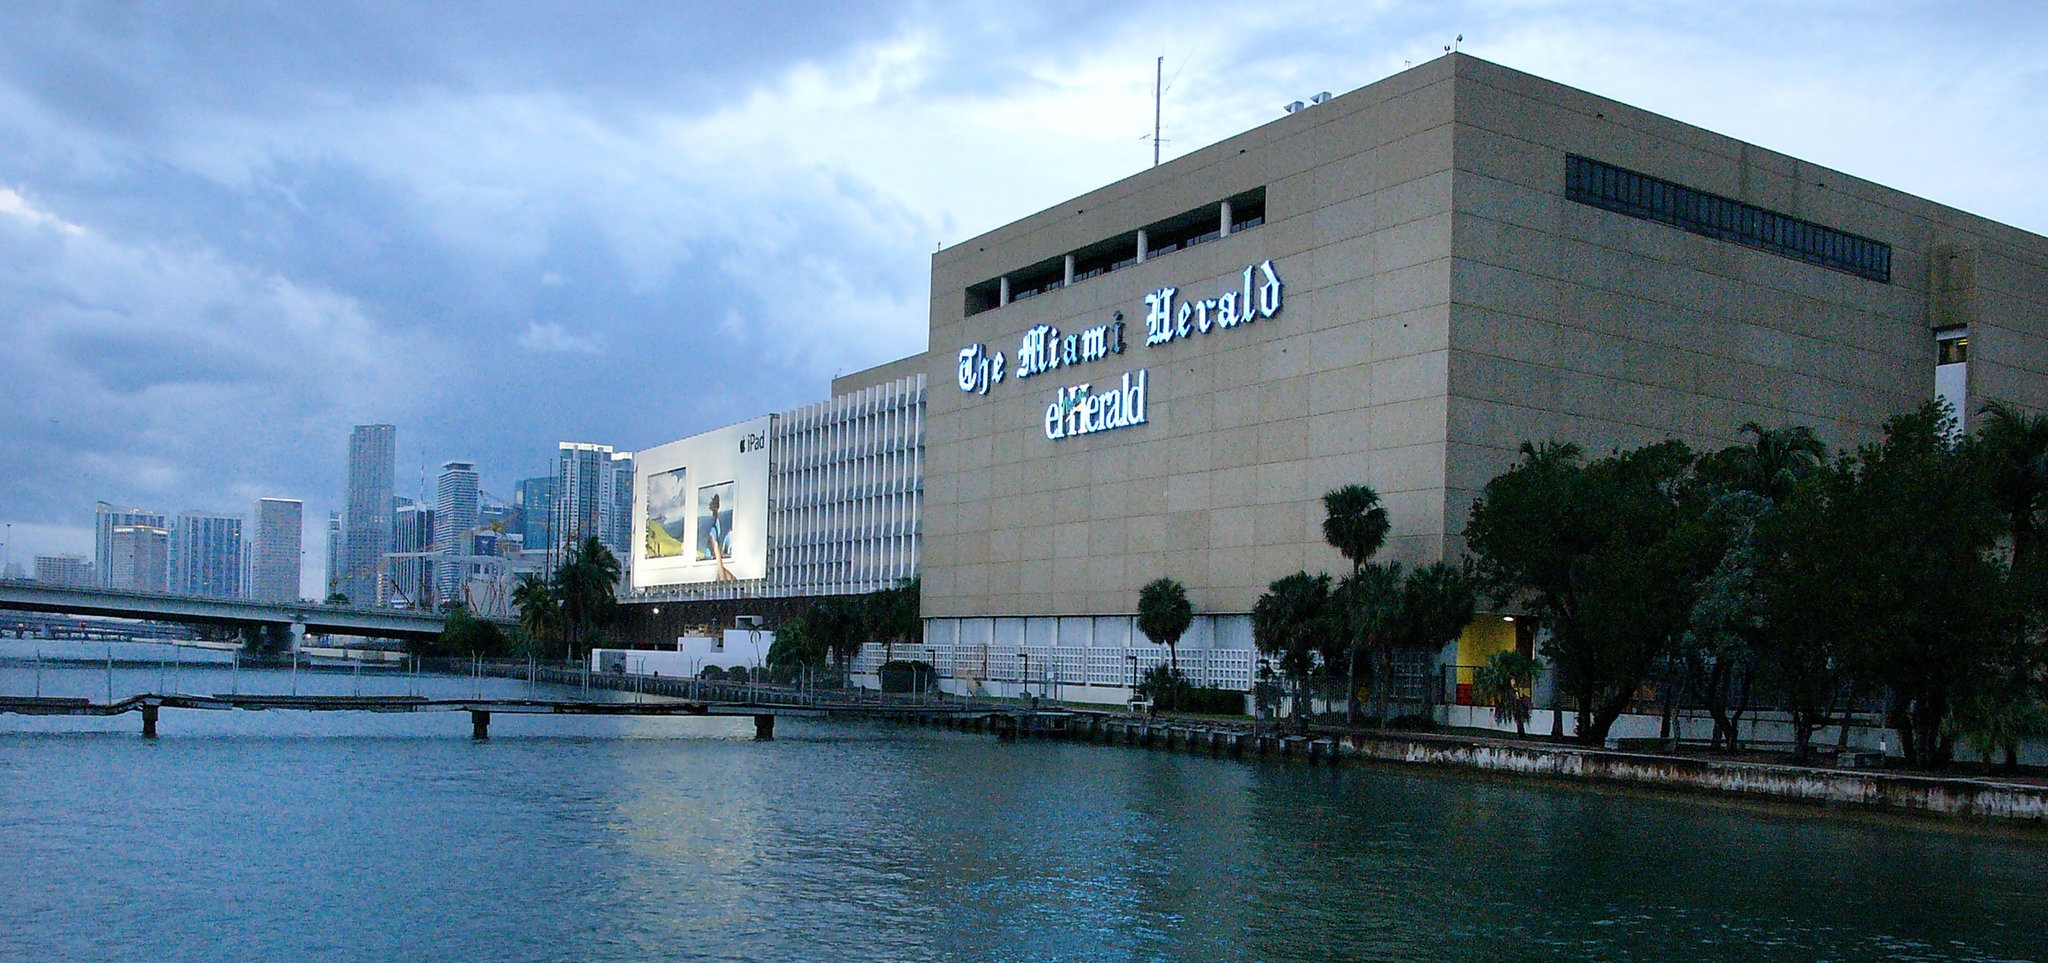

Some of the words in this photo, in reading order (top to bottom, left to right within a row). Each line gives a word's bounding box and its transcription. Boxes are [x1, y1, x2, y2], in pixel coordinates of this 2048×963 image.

[958, 343, 1005, 395] The
[1016, 310, 1126, 378] Miami
[1145, 259, 1283, 347] Herald
[747, 429, 765, 452] iPad
